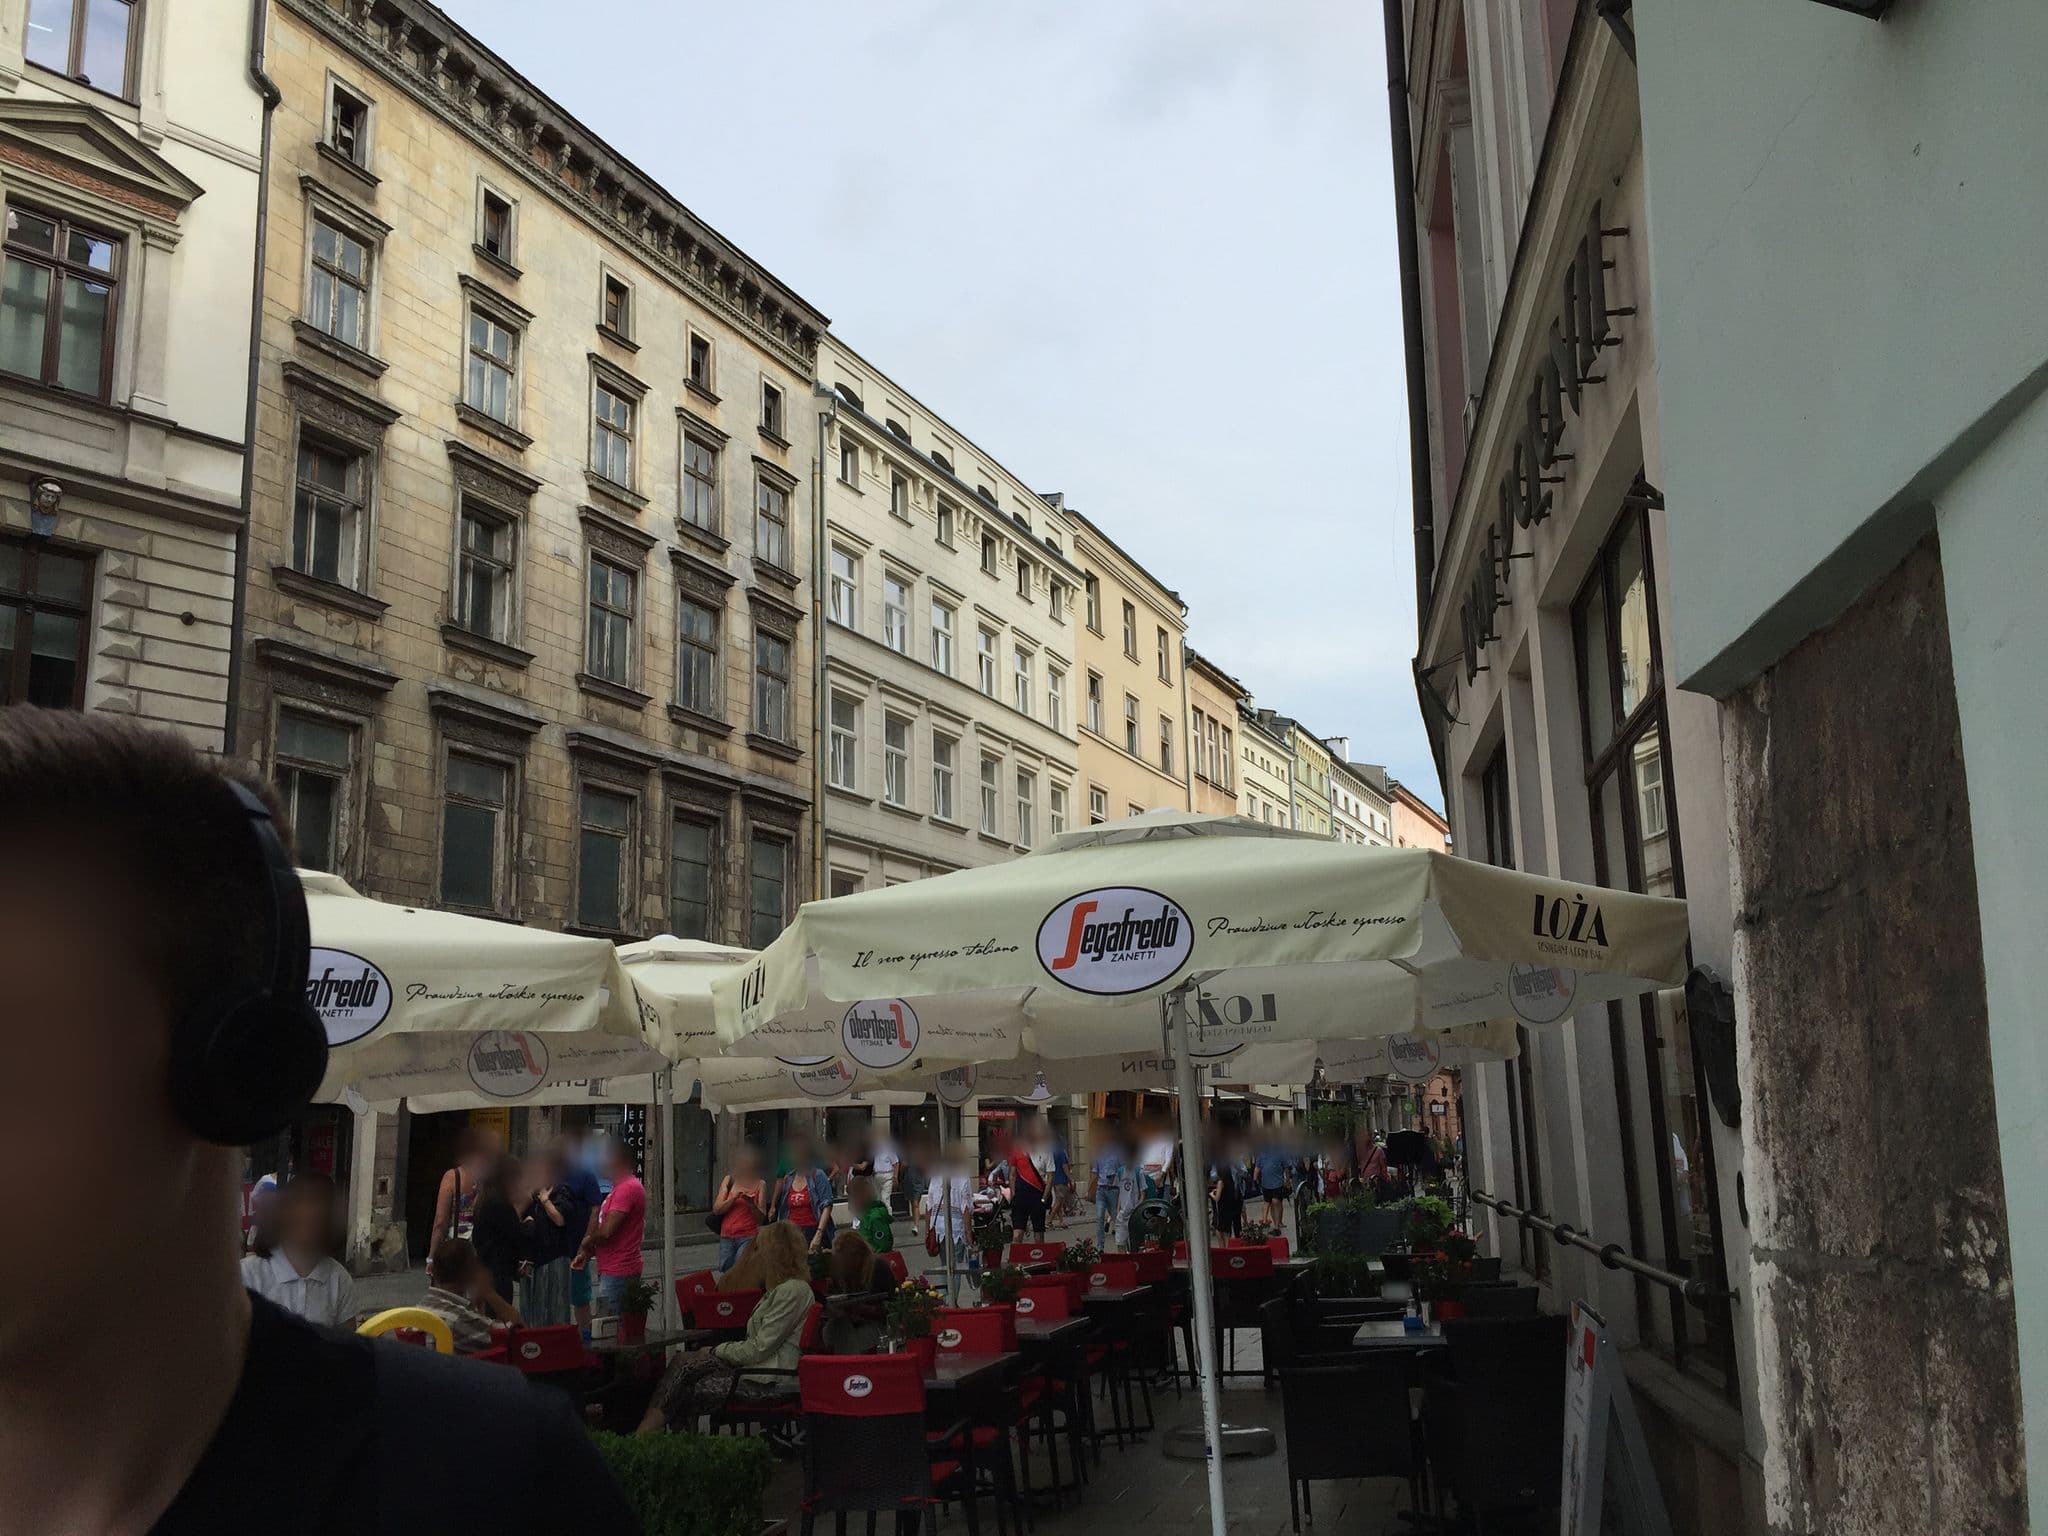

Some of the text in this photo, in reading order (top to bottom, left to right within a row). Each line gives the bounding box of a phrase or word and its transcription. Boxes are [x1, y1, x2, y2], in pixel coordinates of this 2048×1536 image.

[1351, 914, 1407, 937] espresso
[1533, 893, 1609, 947] LOŻA
[1052, 901, 1180, 970] Segafredo
[852, 950, 874, 968] Il
[909, 950, 959, 971] espresso
[1110, 950, 1157, 963] ZANETTI
[305, 967, 379, 1008] afredo
[540, 992, 585, 1008] espresso
